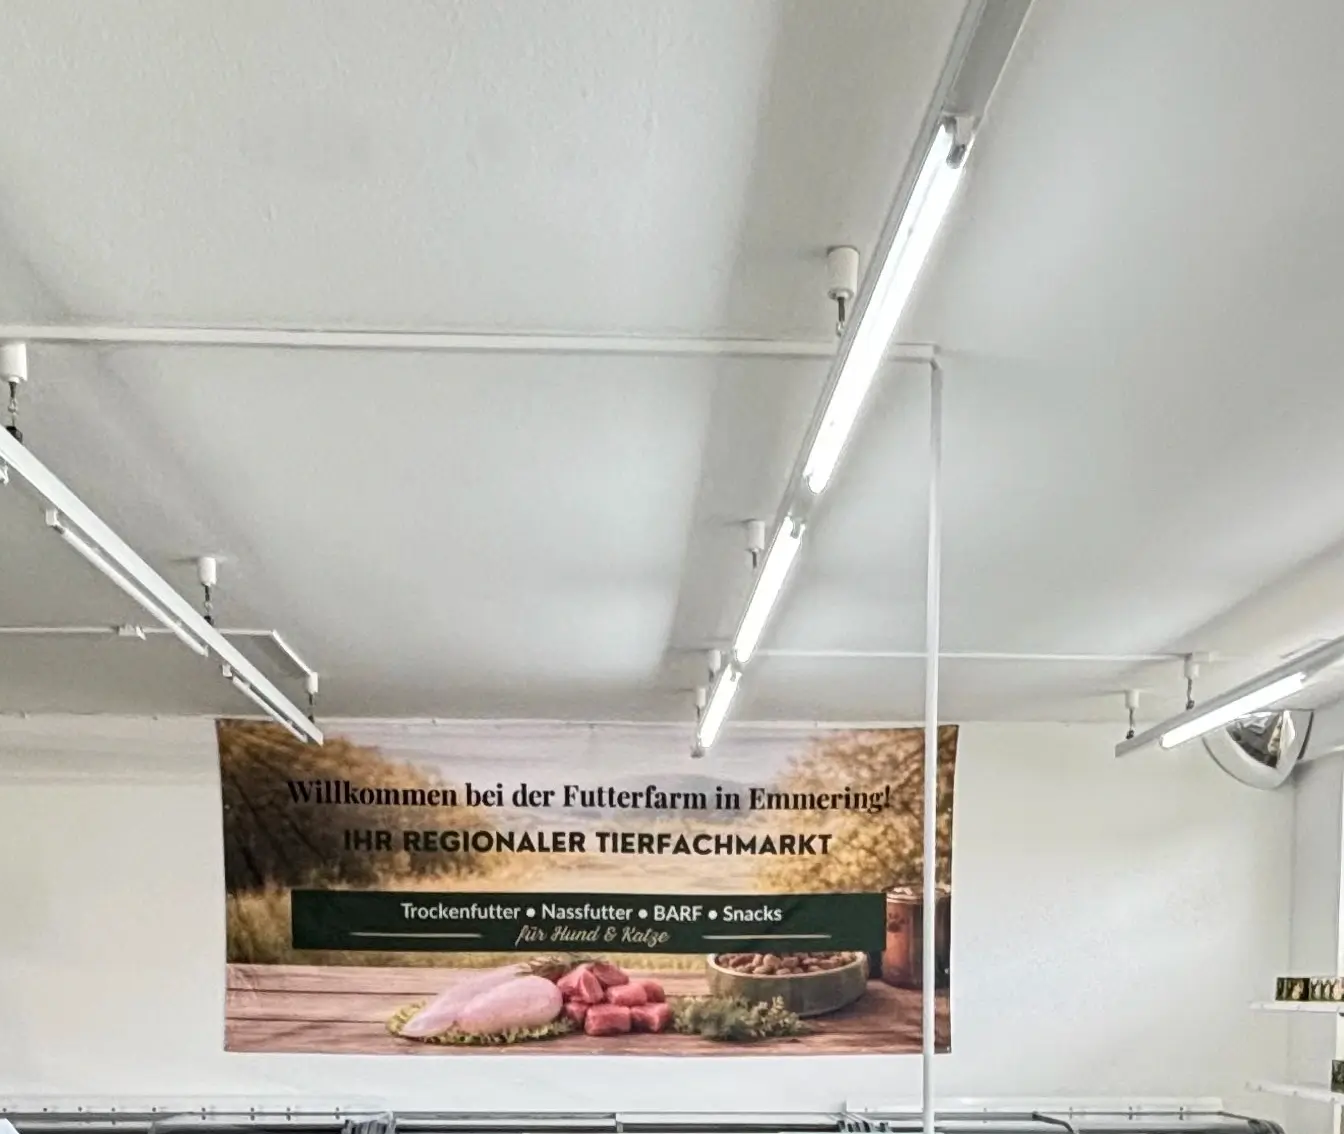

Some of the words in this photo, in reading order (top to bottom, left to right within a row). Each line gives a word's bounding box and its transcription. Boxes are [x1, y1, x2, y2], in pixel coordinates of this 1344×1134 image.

[287, 780, 457, 807] Willkommen
[465, 782, 504, 807] bei
[512, 783, 555, 807] der
[563, 784, 707, 810] Futterfarm
[715, 786, 740, 810] in
[748, 785, 891, 814] Emmering!
[344, 829, 392, 851] IHR
[403, 830, 586, 853] REGIONALER
[596, 831, 833, 855] TIERFACHMARKT
[400, 902, 521, 920] Trockenfutter
[541, 903, 634, 921] Nassfutter
[653, 905, 704, 922] BARF
[722, 905, 783, 922] Snacks
[514, 924, 545, 947] für
[550, 924, 601, 943] Hund
[603, 925, 617, 942] &
[620, 925, 670, 948] Katze
